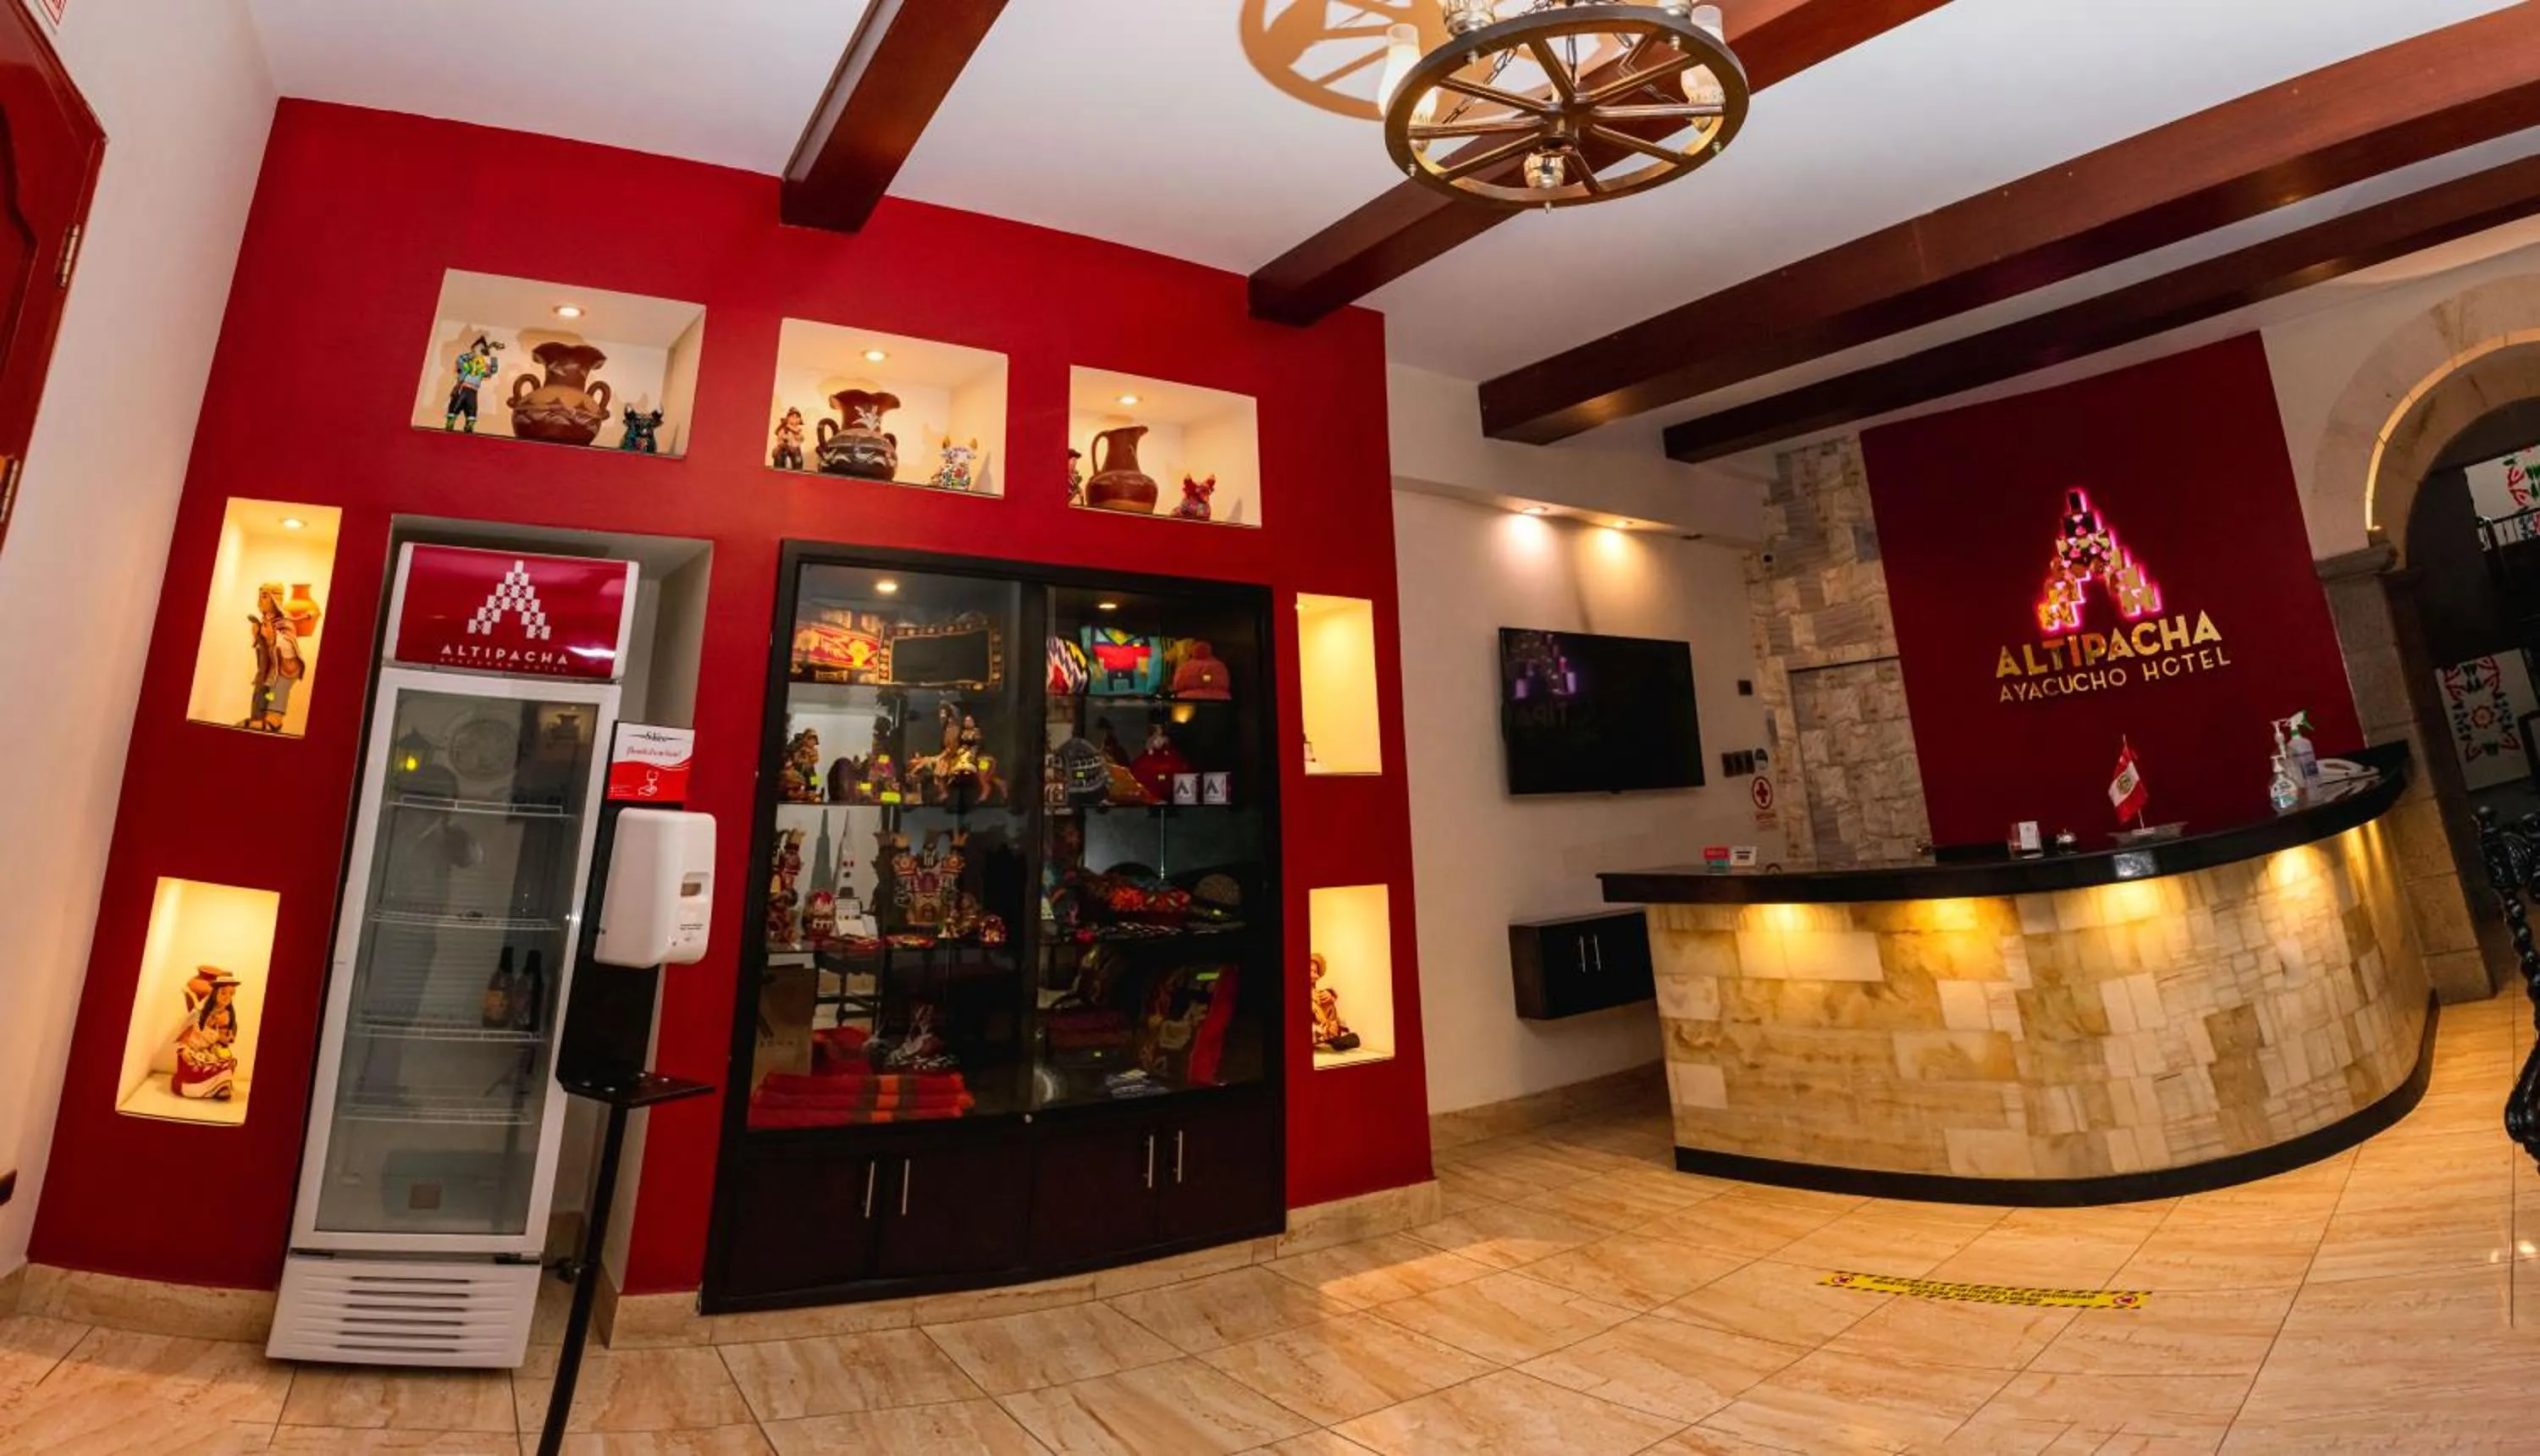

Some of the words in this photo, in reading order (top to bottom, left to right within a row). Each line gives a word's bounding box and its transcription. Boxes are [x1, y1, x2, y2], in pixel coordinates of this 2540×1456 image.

[441, 643, 568, 665] ALTIPACHA
[1996, 609, 2222, 678] ALTIPACHA
[1999, 668, 2127, 703] AYACUCHO
[2141, 647, 2232, 681] HOTEL
